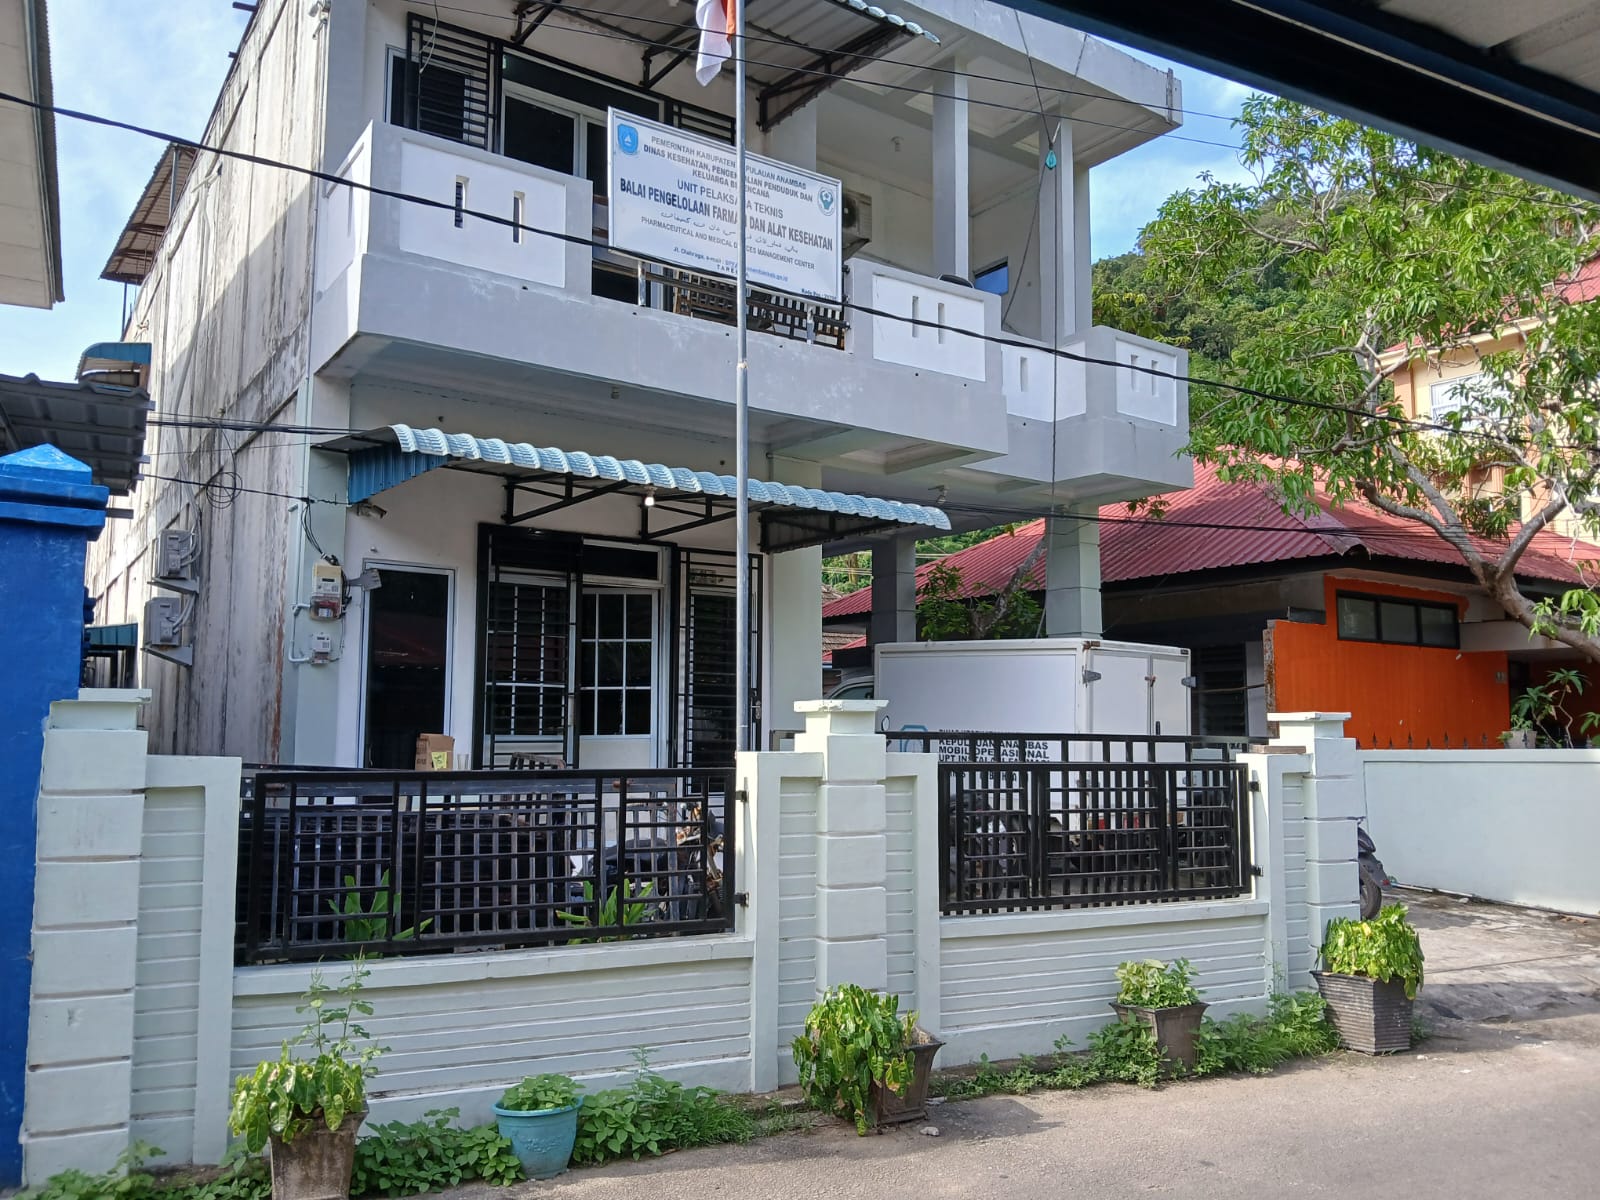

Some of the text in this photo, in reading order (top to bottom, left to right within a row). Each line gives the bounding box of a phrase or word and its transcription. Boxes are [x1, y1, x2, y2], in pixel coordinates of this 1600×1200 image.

[643, 144, 666, 158] DINAS
[764, 181, 799, 198] PENDUDUK
[800, 191, 813, 203] DAN
[651, 136, 807, 190] PEMERINTAH KABUPATEN PULAUAN ANAMBAS
[692, 169, 729, 186] KELUARGA
[620, 178, 646, 198] BALAI
[648, 187, 711, 217] PENGELOLAAN
[749, 216, 766, 233] DAN
[767, 221, 787, 238] ALAT
[788, 227, 833, 251] KESEHATAN
[677, 179, 698, 194] UNIT
[753, 202, 784, 219] TEKNIS
[641, 216, 693, 237] PHARMACEUTICAL
[695, 231, 707, 241] AND
[708, 234, 733, 247] MEDICAL
[757, 247, 793, 264] MANAGEMENT
[794, 259, 815, 270] CENTER
[938, 738, 1049, 750] KEPULUAN ANABAS
[938, 746, 970, 755] MOBIL
[938, 754, 956, 762] UPT
